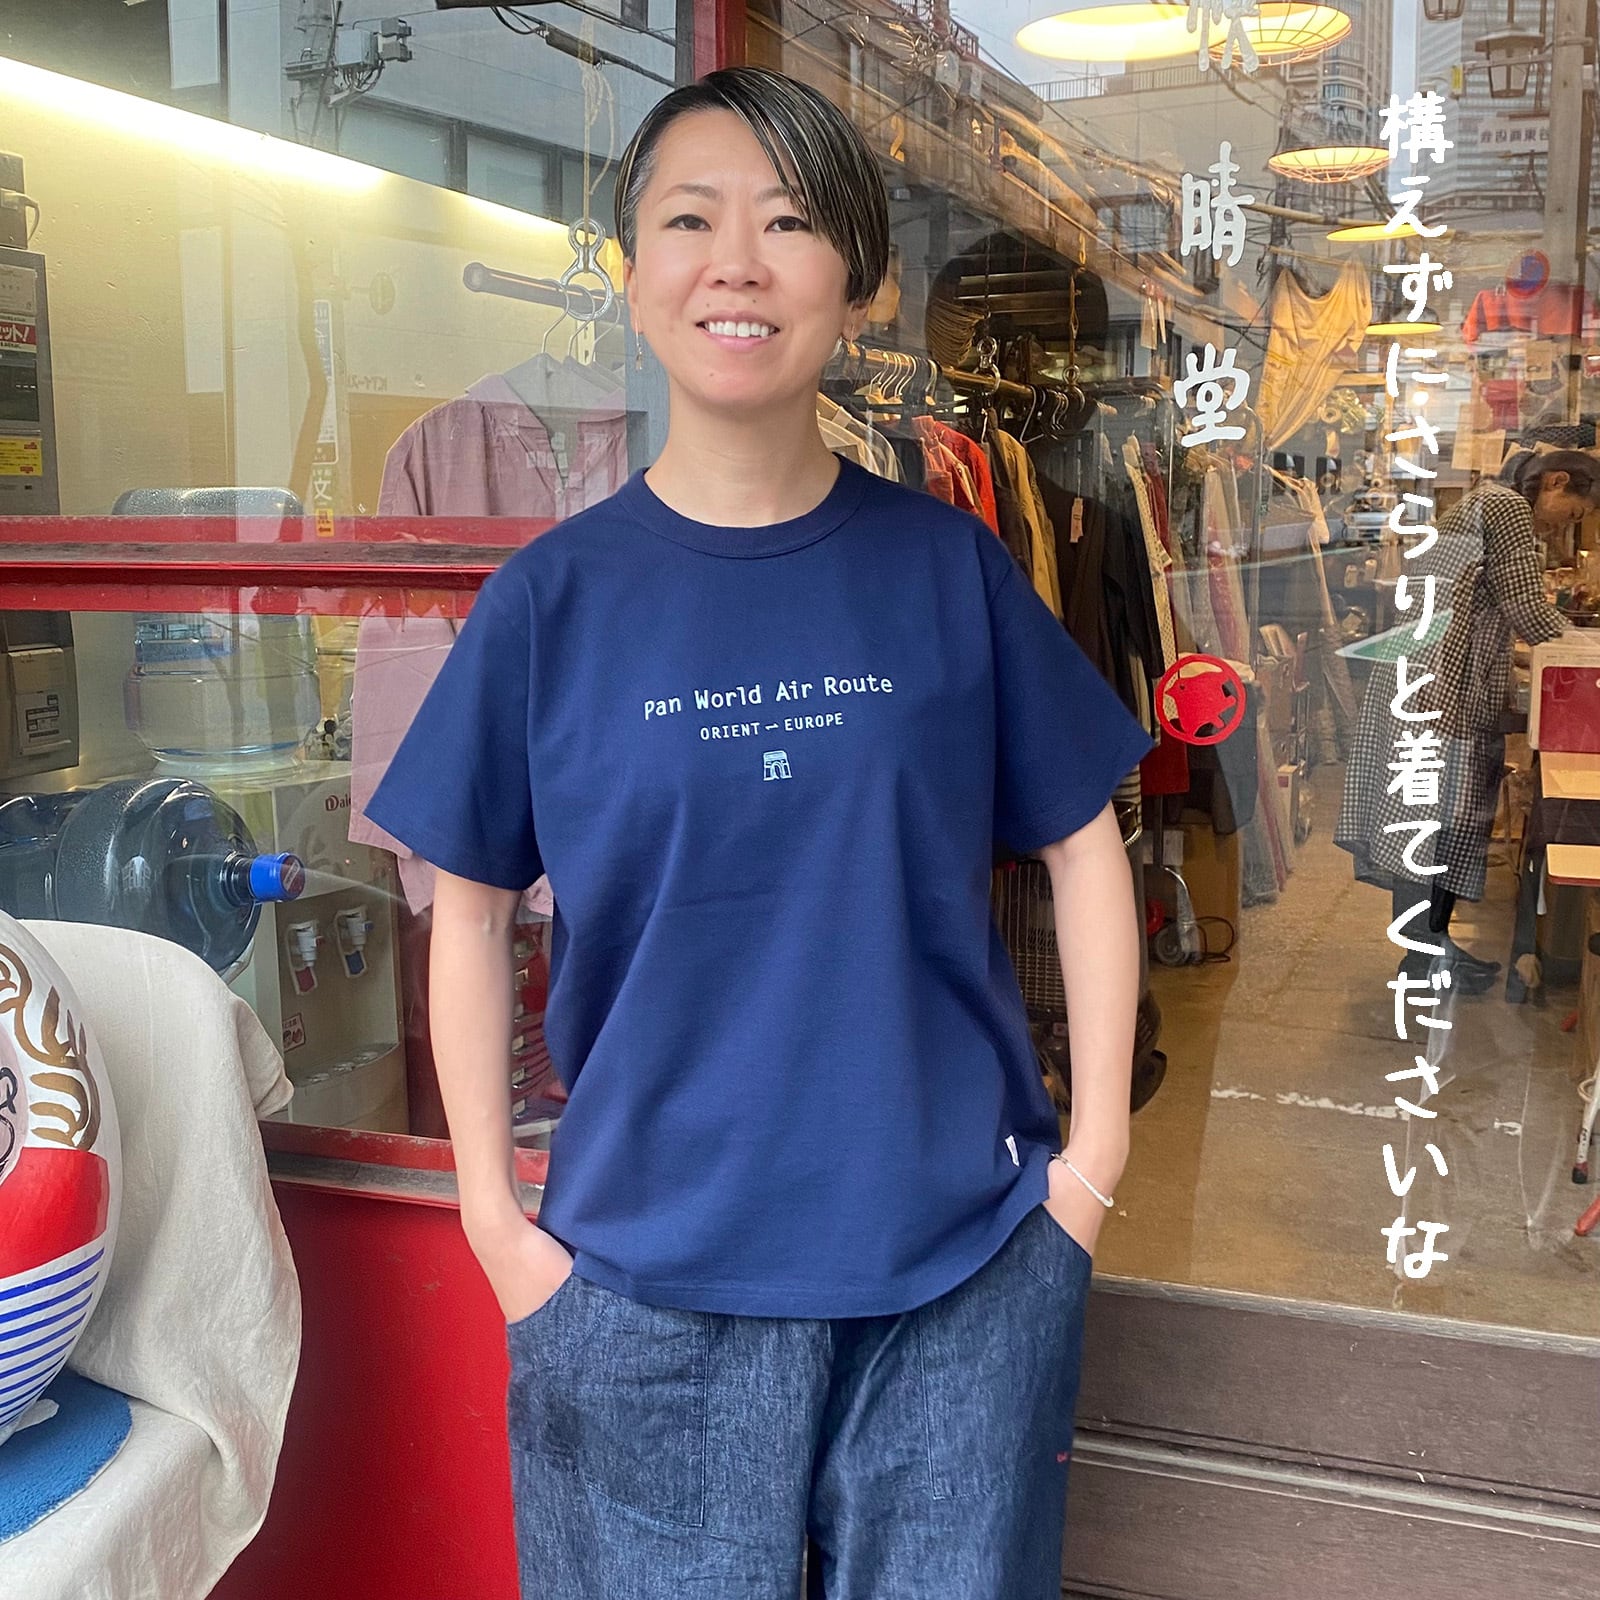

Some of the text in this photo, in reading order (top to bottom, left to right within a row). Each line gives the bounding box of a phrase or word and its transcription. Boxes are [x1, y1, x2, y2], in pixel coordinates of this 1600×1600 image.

[644, 673, 893, 720] Pan World Air Route
[700, 712, 844, 741] ORIENT EUROPE
